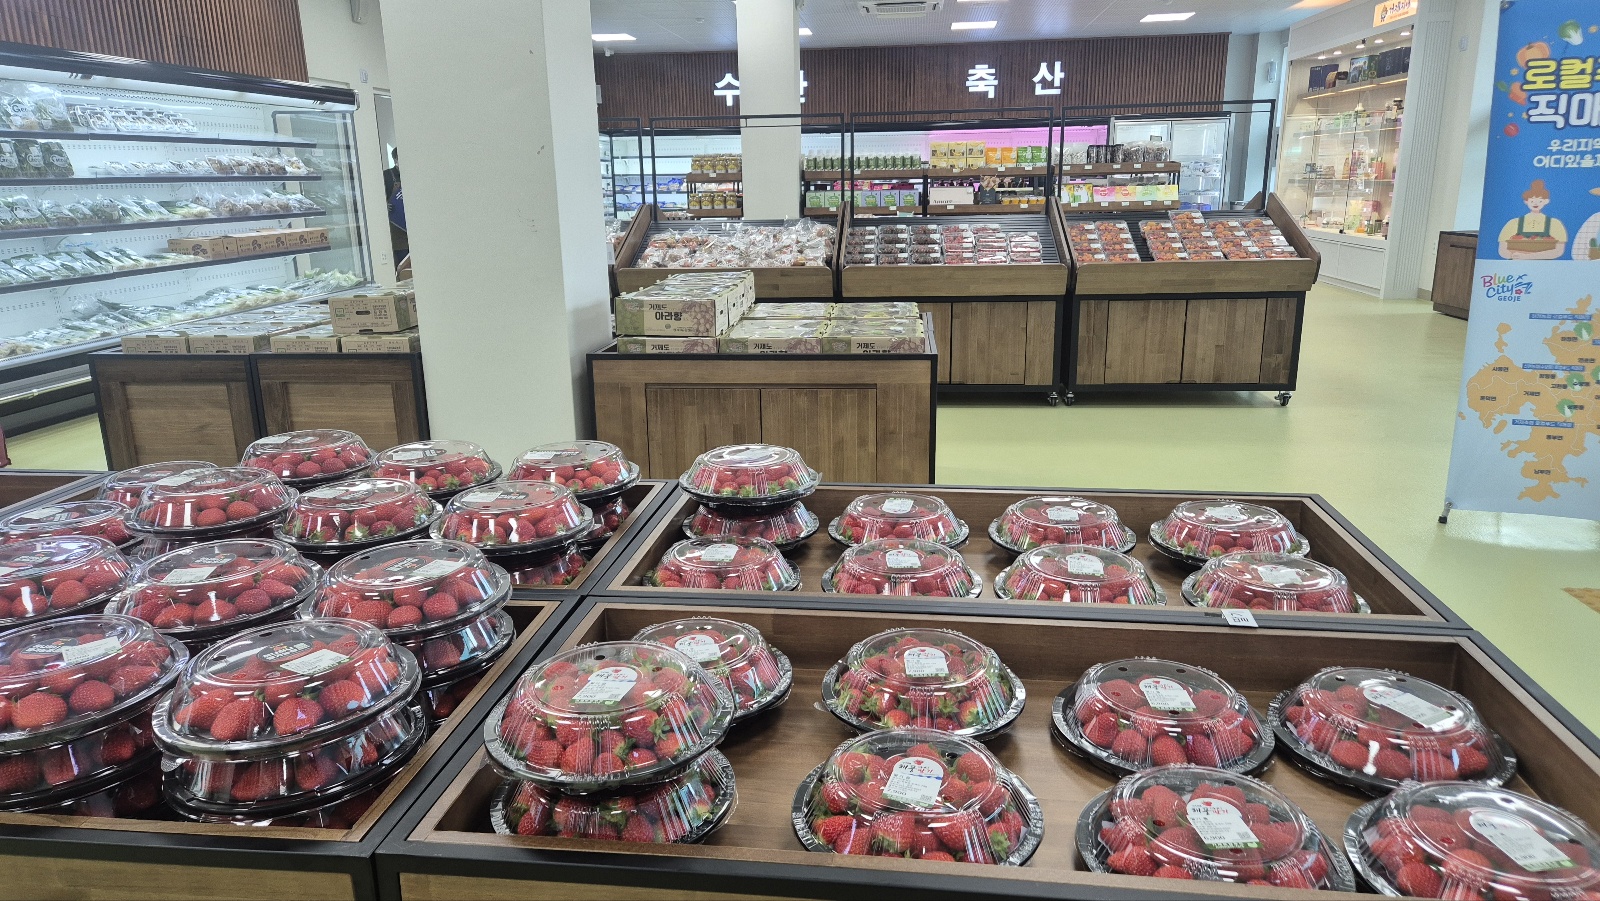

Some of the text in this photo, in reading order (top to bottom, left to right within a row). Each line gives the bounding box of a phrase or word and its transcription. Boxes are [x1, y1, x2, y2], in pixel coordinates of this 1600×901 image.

[1522, 57, 1600, 90] 로컬
[1480, 273, 1515, 288] Blue
[1486, 284, 1514, 298] City
[655, 311, 682, 321] 아라향
